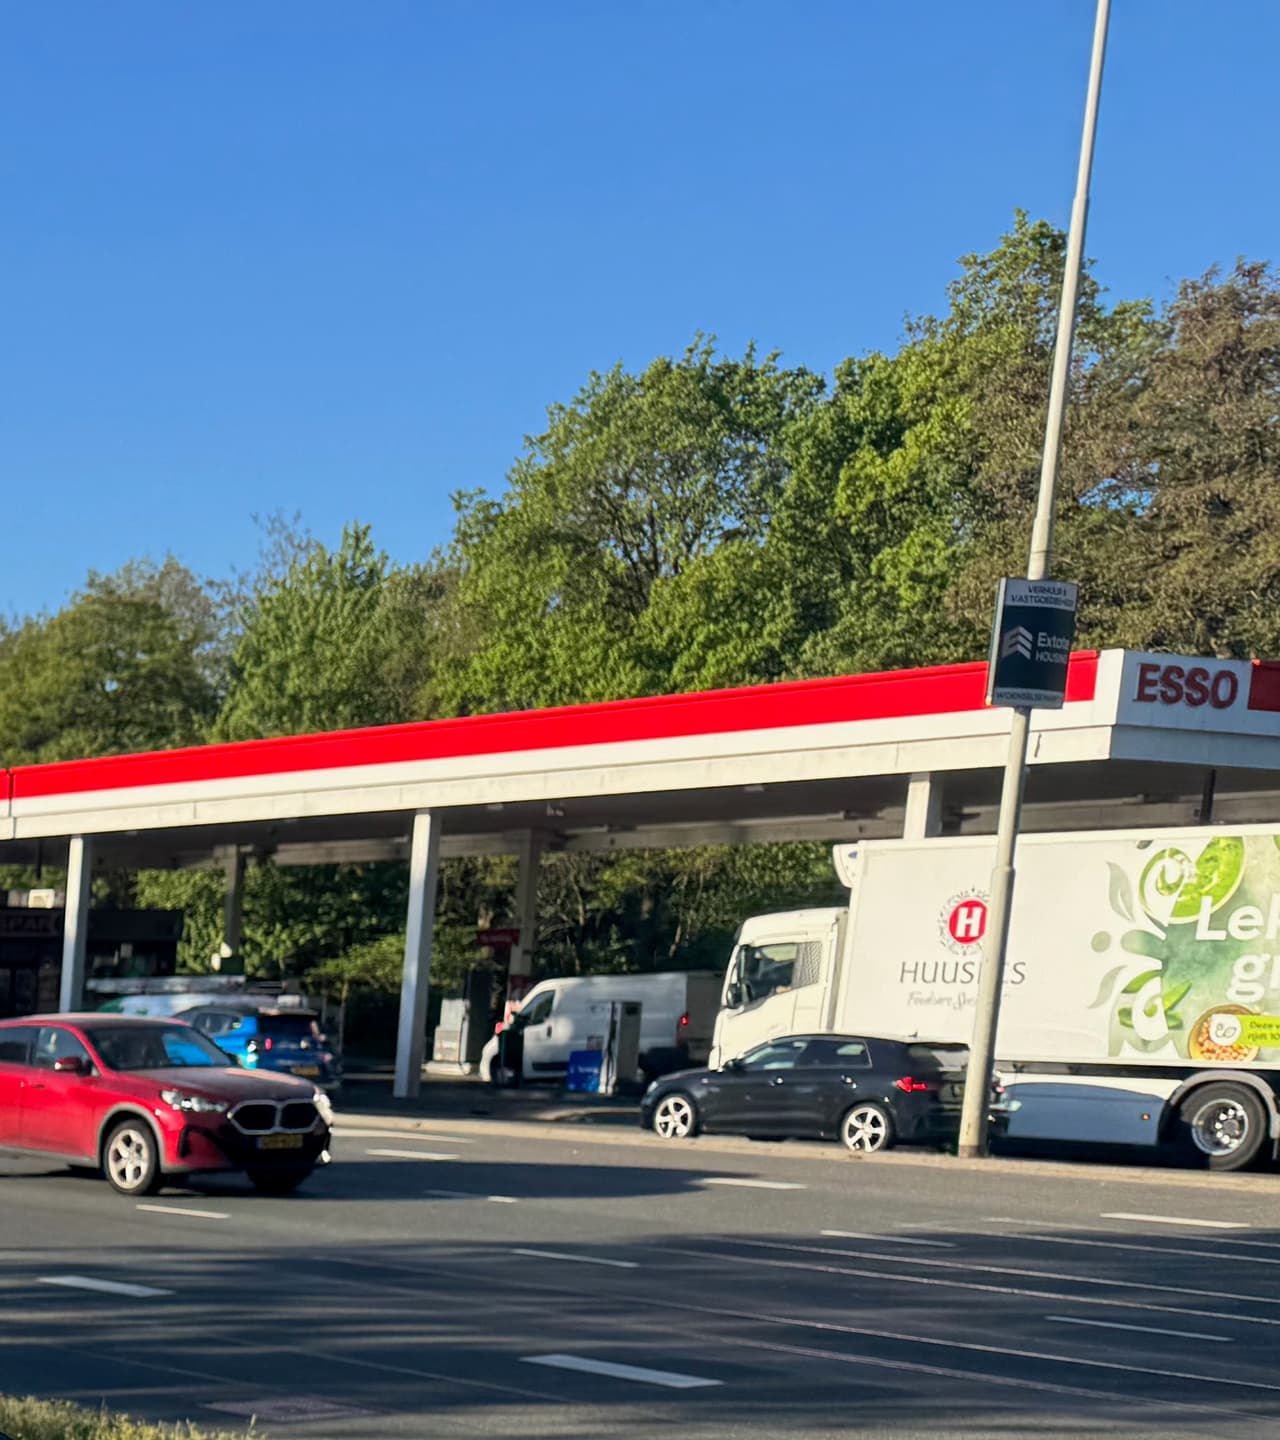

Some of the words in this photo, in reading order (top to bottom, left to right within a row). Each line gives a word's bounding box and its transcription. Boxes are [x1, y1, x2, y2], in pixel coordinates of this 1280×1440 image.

[1136, 663, 1239, 710] ESSO
[955, 906, 983, 937] H
[899, 961, 1027, 985] HUUSS
